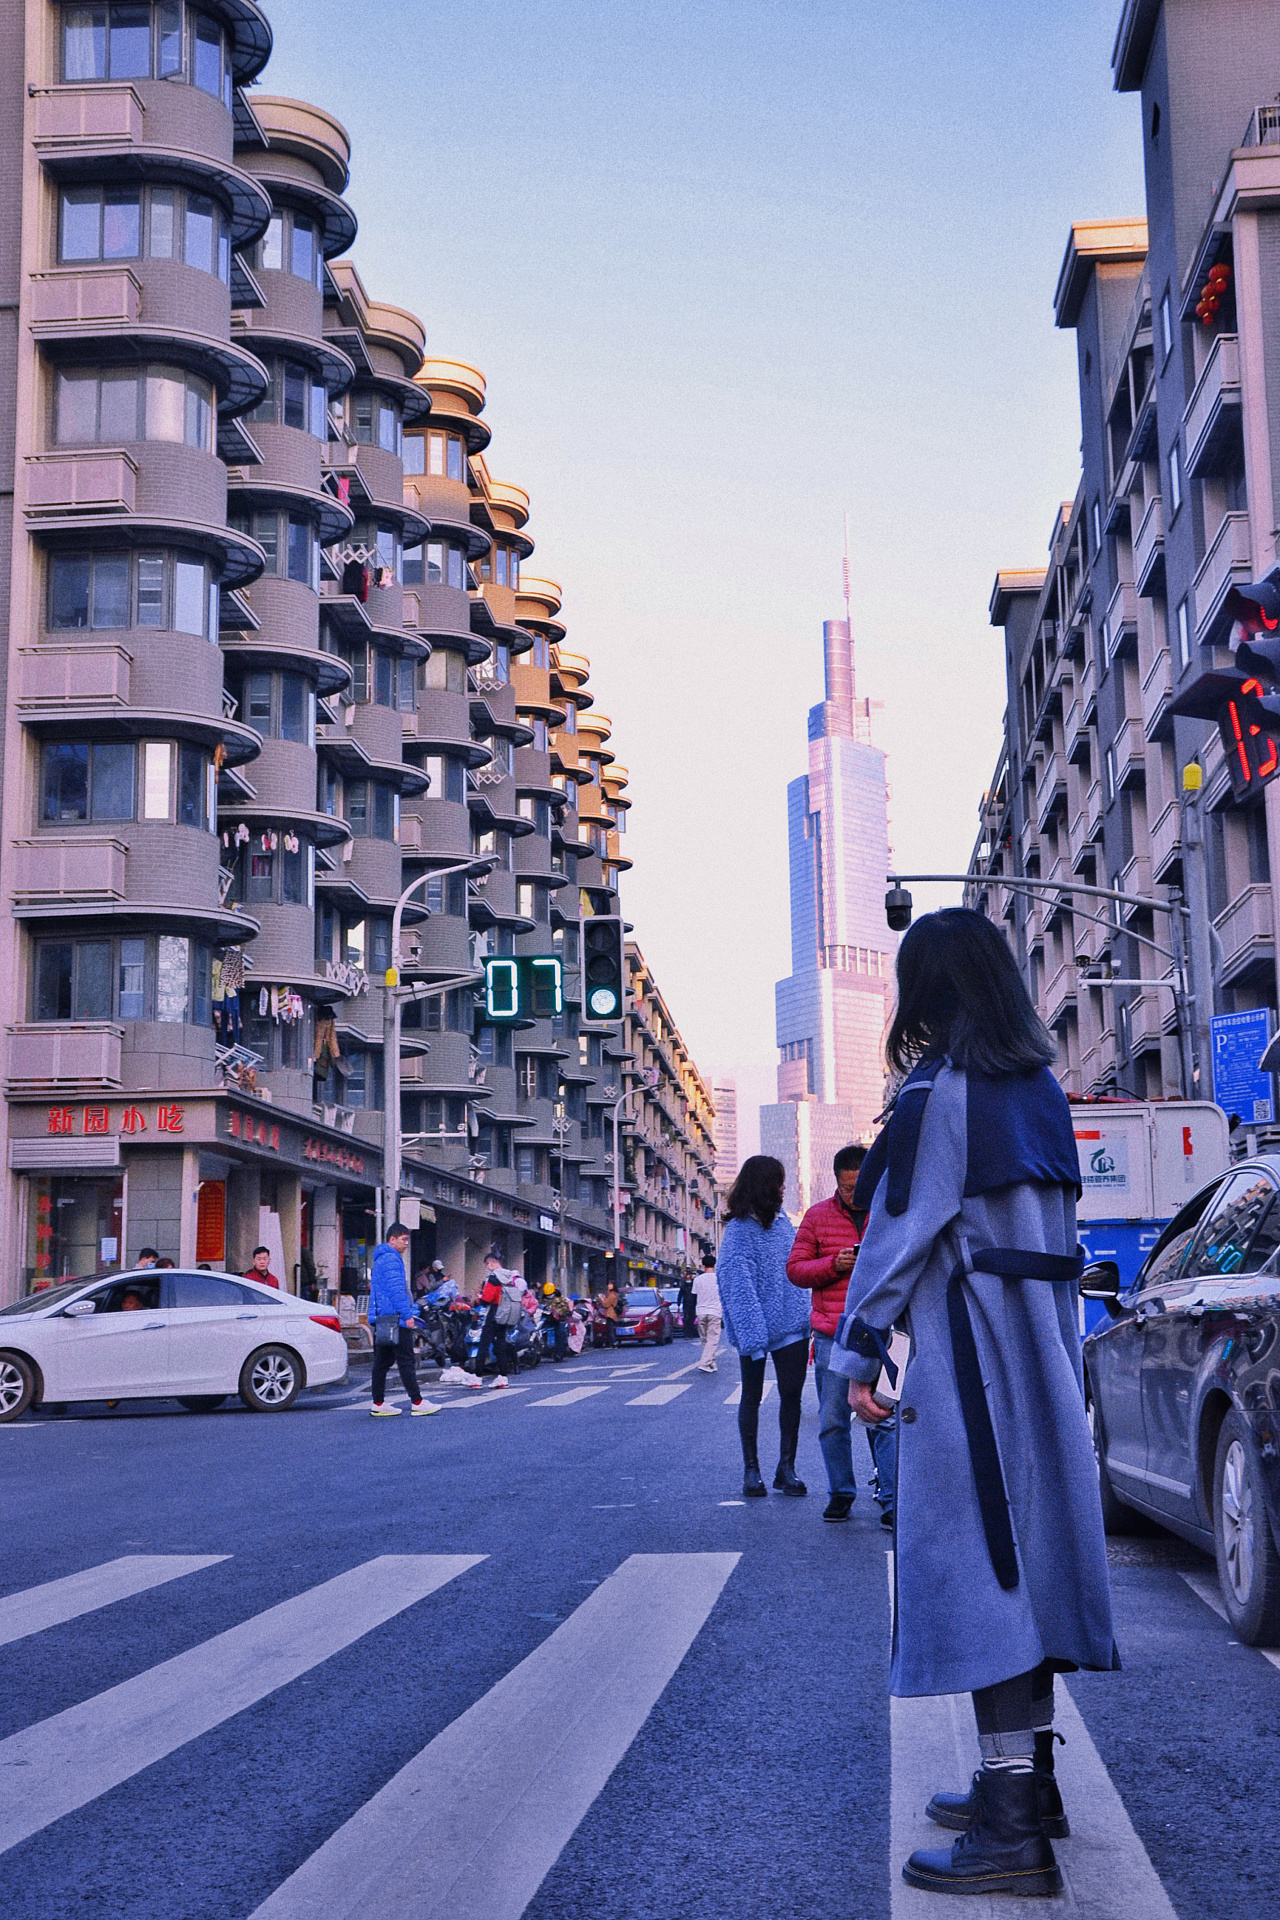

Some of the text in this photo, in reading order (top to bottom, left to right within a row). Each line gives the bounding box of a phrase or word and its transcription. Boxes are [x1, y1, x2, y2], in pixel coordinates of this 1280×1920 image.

[486, 958, 563, 1017] 07
[1216, 1034, 1227, 1053] P
[47, 1104, 185, 1133] 新园小吃
